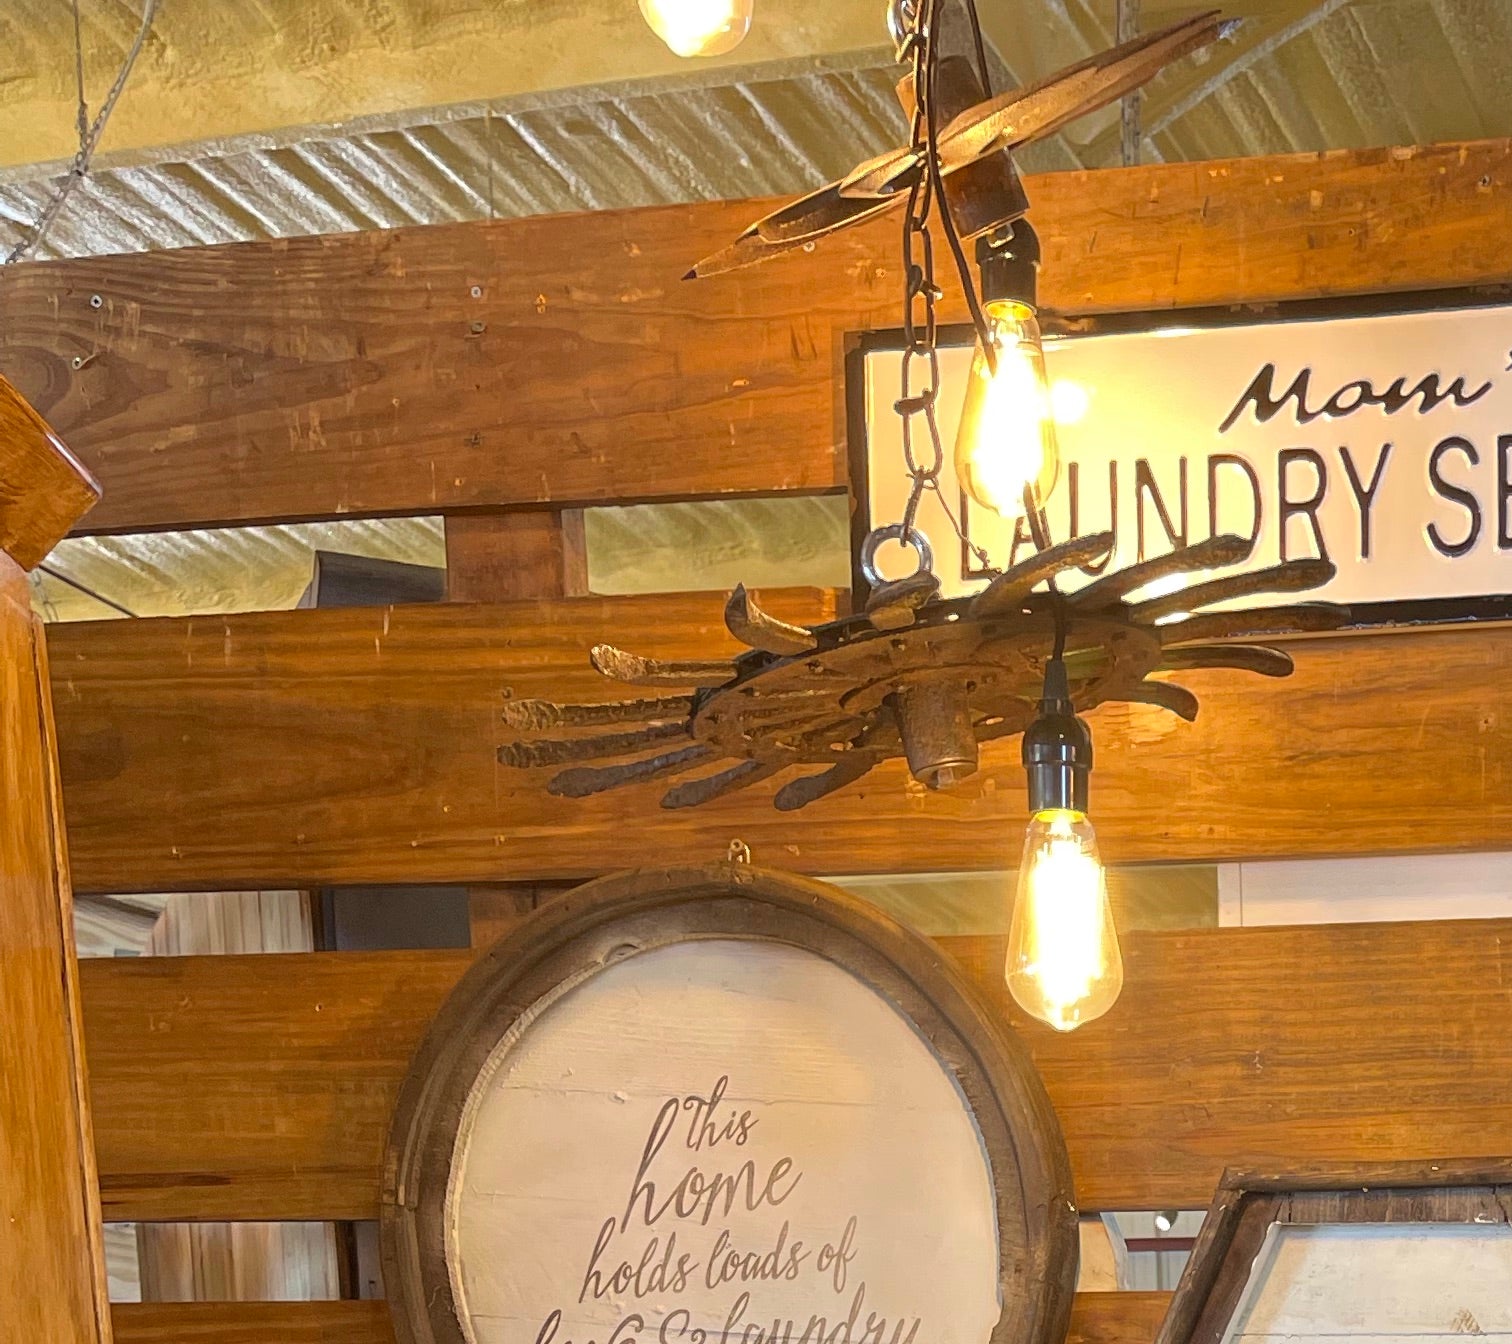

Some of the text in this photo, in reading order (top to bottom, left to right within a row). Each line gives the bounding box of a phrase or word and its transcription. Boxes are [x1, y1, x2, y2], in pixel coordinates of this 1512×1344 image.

[683, 1074, 760, 1151] This
[619, 1097, 803, 1234] home
[578, 1214, 858, 1305] holds loads of
